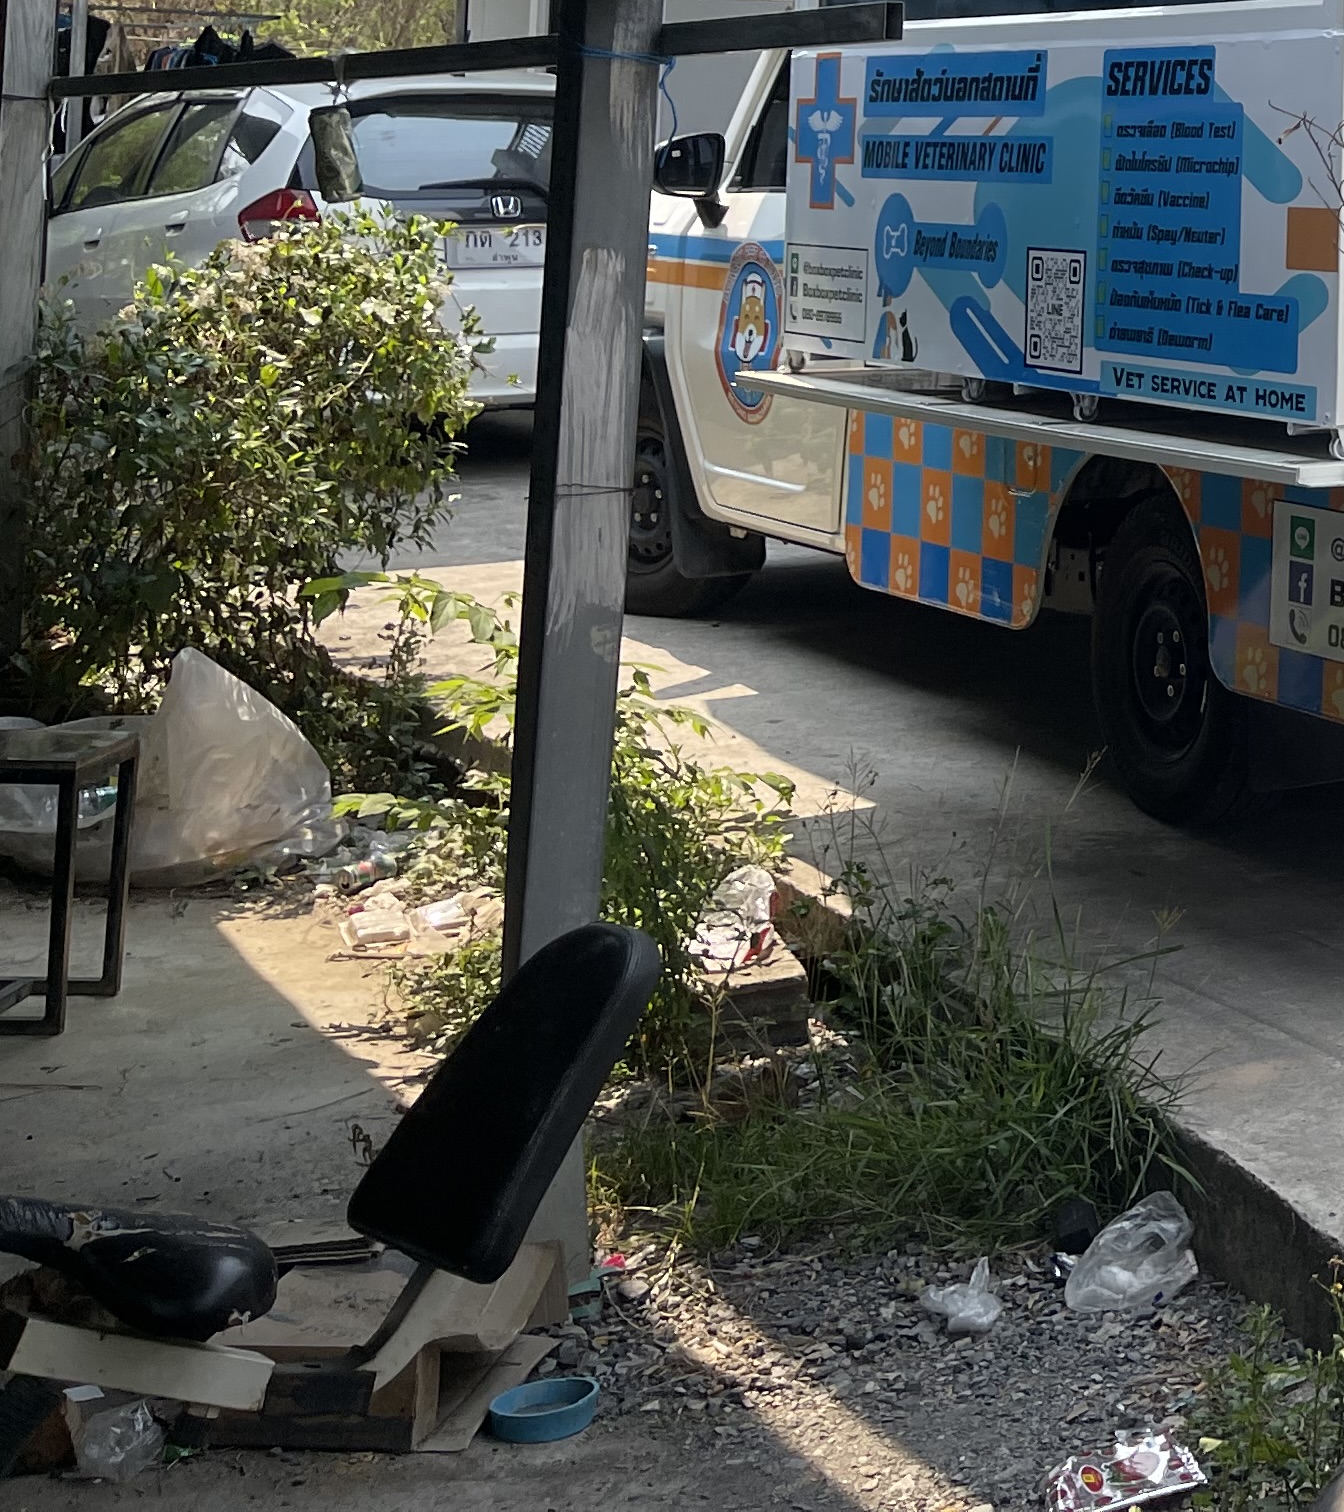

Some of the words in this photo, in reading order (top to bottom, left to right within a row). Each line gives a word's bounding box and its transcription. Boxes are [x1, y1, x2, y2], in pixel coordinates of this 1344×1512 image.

[869, 53, 1042, 103] รักษาสัตว์นอกสถานที่
[1106, 58, 1213, 97] SERVICES
[864, 140, 911, 169] MOBILE
[914, 141, 997, 173] VETERINARY
[999, 142, 1047, 175] CLINIC
[913, 229, 949, 263] Beyond
[949, 231, 999, 263] Boundaries
[1112, 366, 1145, 389] VET
[1151, 374, 1217, 400] SERVICE
[1224, 384, 1248, 404] AT
[1255, 387, 1306, 413] HOME
